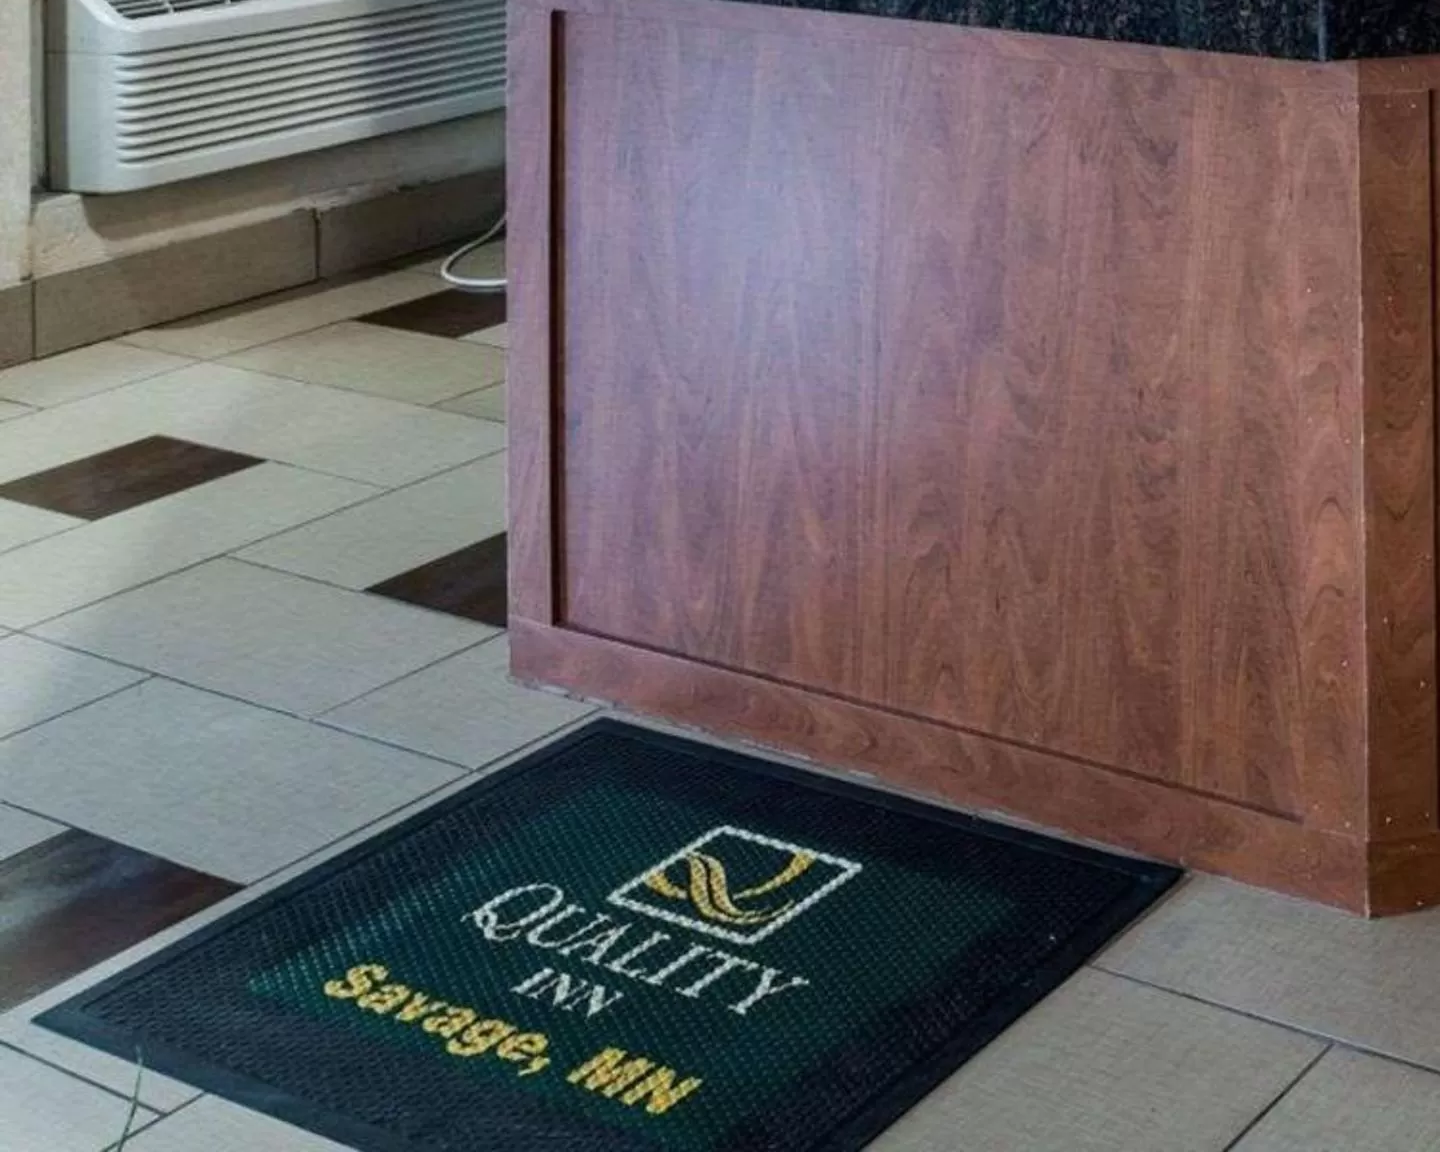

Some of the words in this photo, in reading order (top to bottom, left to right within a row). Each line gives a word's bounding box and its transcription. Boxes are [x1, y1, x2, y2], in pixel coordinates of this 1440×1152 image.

[460, 883, 809, 1015] QUALITY
[510, 967, 624, 1017] INN
[324, 963, 550, 1076] Savage,
[566, 1047, 703, 1115] MN
